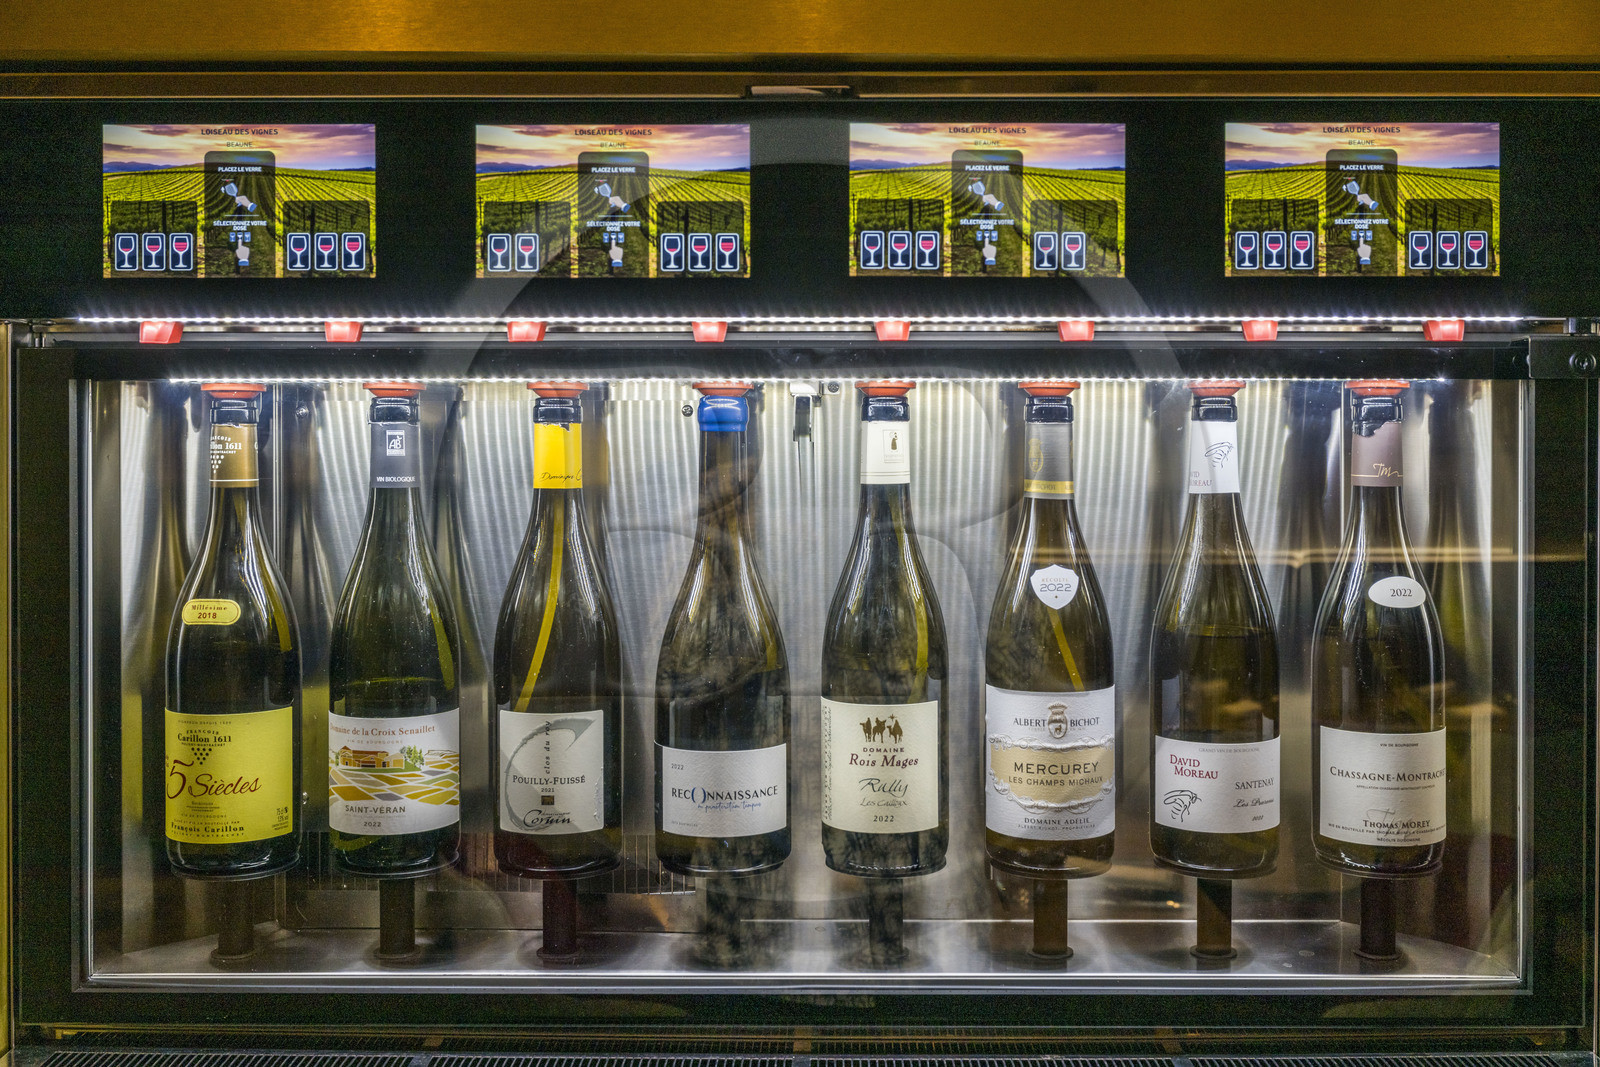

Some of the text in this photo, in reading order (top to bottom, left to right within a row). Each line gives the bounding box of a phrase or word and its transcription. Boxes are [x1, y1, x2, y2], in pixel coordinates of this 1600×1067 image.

[1040, 584, 1071, 592] 2022
[1013, 717, 1100, 727] ALBERT BICHOT
[362, 728, 369, 736] la
[371, 728, 396, 736] Croix
[399, 725, 435, 735] Senaillet
[178, 733, 209, 742] Carillon
[544, 741, 550, 751] du
[849, 753, 918, 769] Rois Mages
[1170, 754, 1200, 767] DAVID
[1014, 761, 1099, 775] MERCUREY
[1174, 766, 1218, 780] MOREAU
[167, 760, 194, 799] 5
[188, 773, 262, 798] Siècles
[513, 775, 586, 785] POUILLY-FUISSÉ
[1009, 776, 1023, 784] LES
[1068, 776, 1103, 786] MICHAUX
[1235, 777, 1274, 789] SANTENAY
[859, 778, 908, 798] Rully
[345, 805, 406, 814] SAINT-VÉRAN
[172, 822, 200, 832] François
[1363, 820, 1430, 829] THOMAS MOREY
